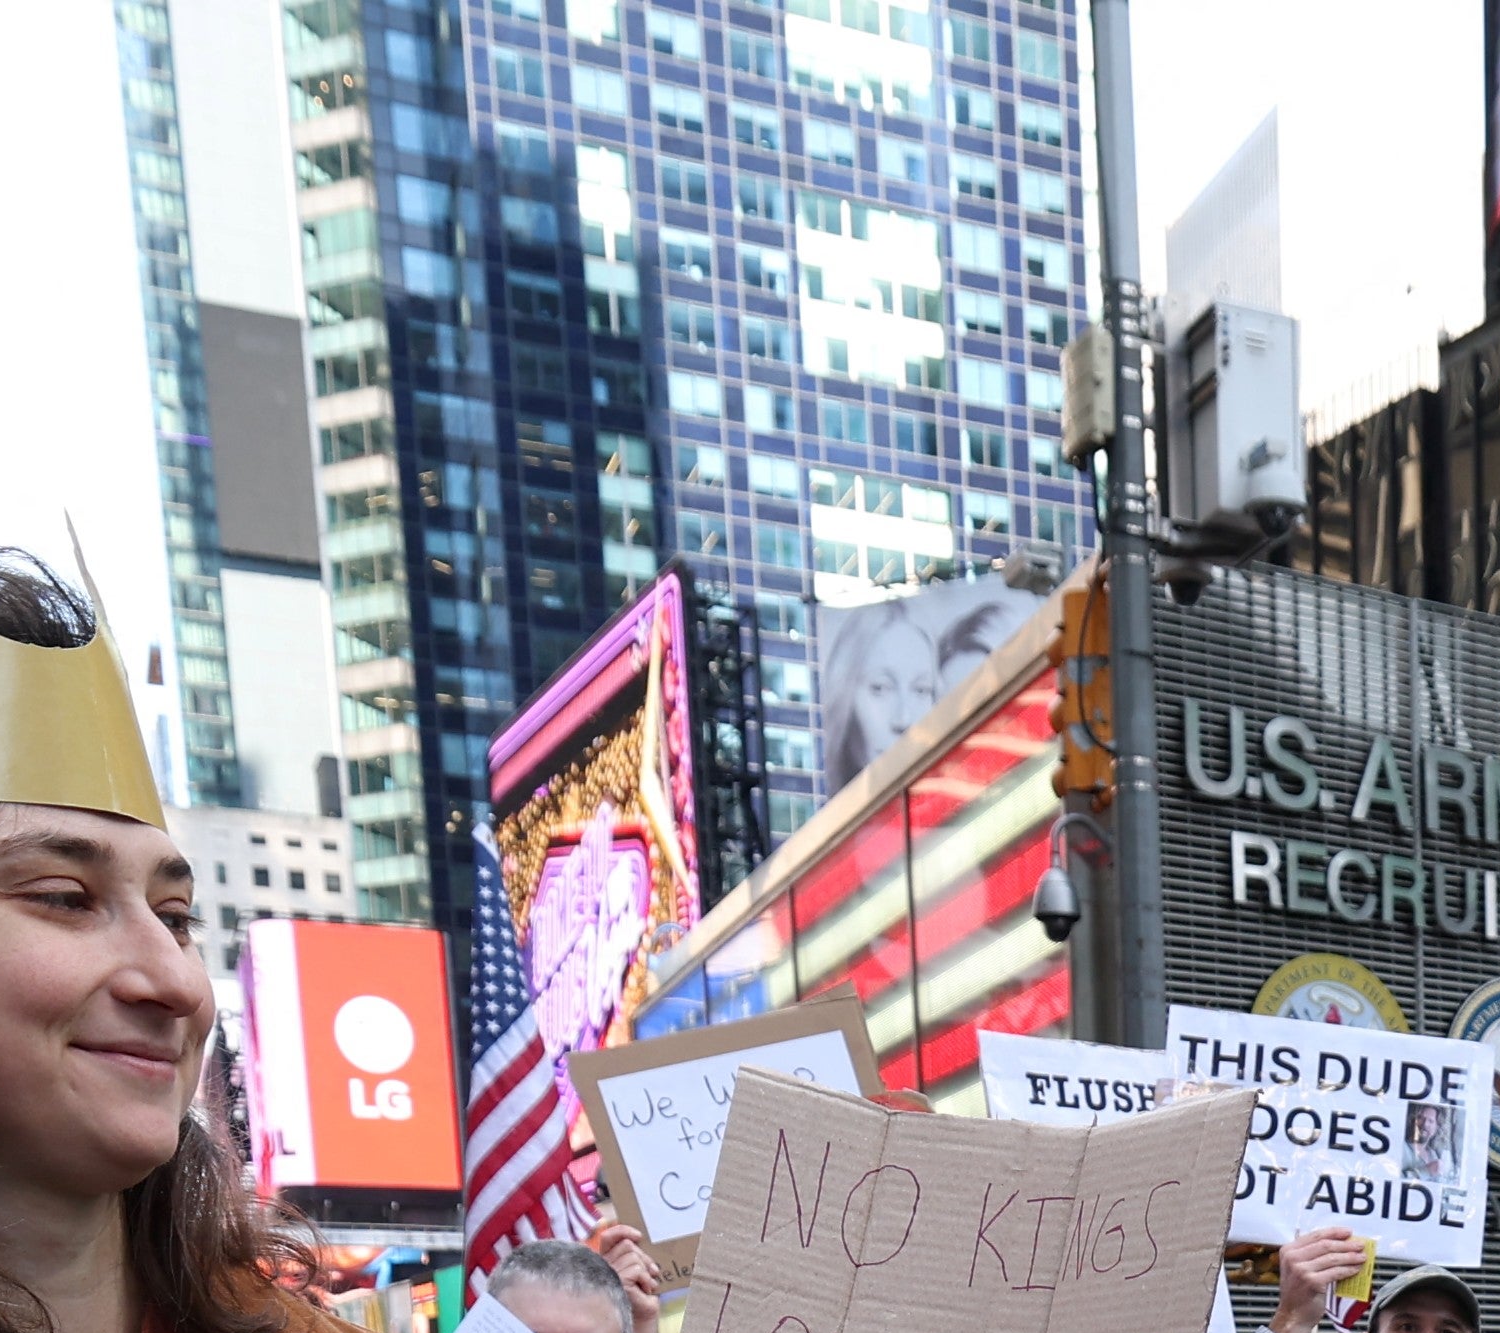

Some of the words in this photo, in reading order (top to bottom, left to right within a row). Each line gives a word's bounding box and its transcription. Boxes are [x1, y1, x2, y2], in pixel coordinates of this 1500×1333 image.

[1182, 698, 1338, 812] U.S.
[347, 1076, 415, 1121] LG
[1024, 1070, 1158, 1114] FLUSH
[1178, 1034, 1302, 1088] THIS
[1316, 1050, 1470, 1107] DUDE
[611, 1087, 679, 1129] We
[677, 1116, 727, 1151] for
[1247, 1101, 1392, 1157] DOES
[760, 1127, 922, 1269] NO
[967, 1179, 1181, 1292] KINGS
[1304, 1172, 1470, 1229] ABIDE
